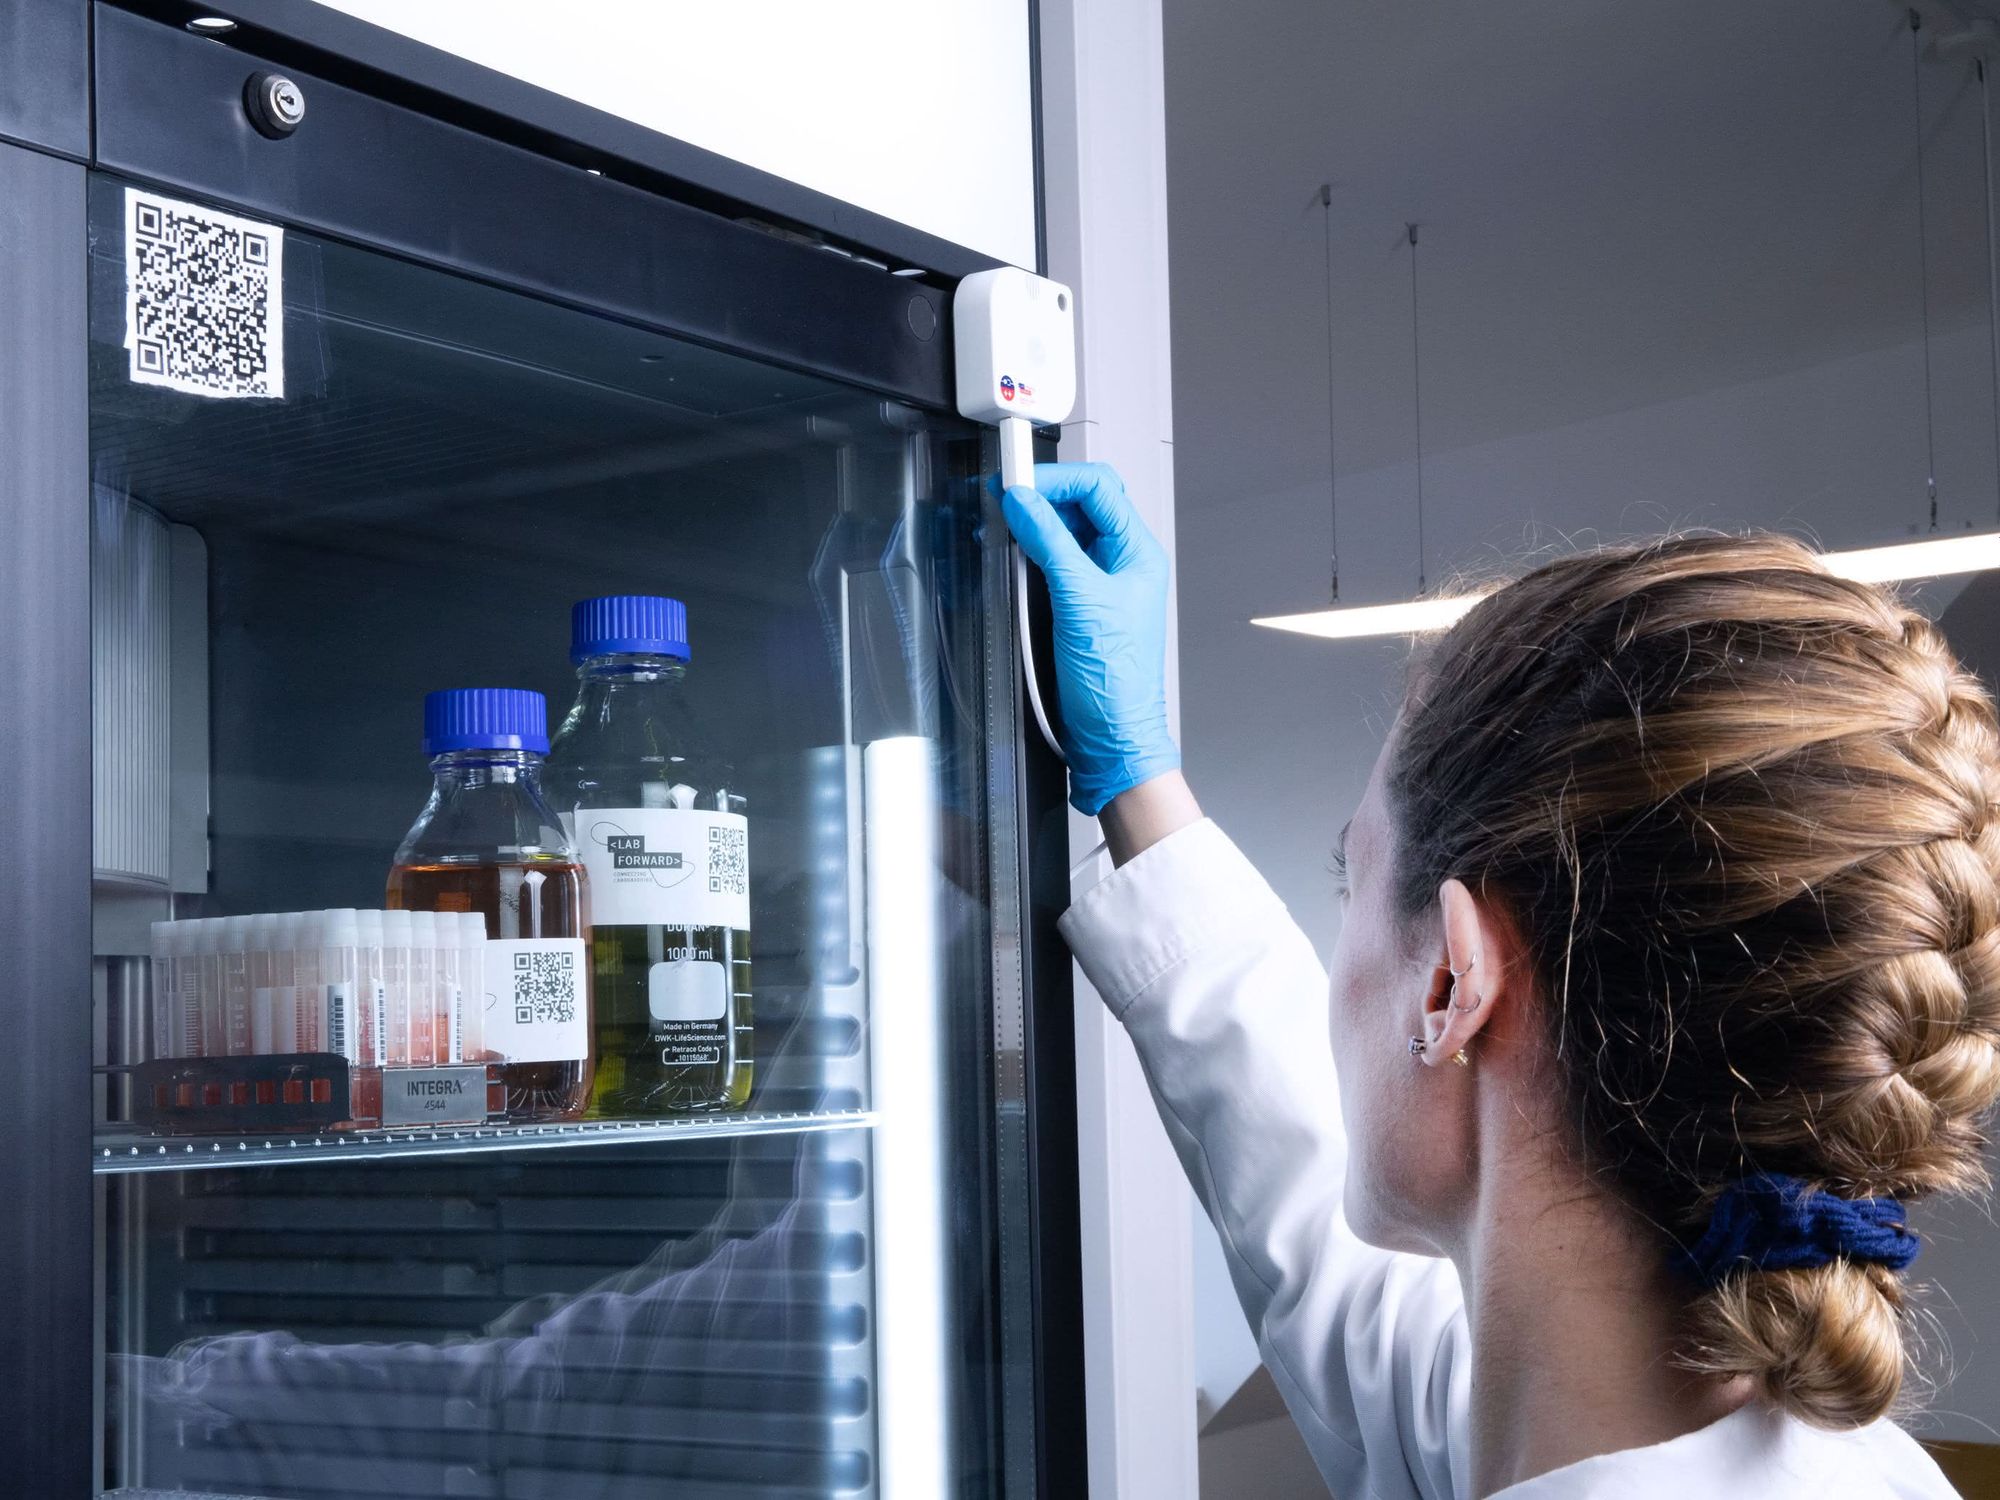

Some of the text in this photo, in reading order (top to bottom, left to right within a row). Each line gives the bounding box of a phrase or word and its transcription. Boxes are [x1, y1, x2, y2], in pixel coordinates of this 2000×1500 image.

[667, 947, 713, 960] 1000 ml
[691, 1022, 719, 1031] Germany
[655, 1033, 727, 1042] DWK-LifeSciences.com
[407, 1080, 462, 1096] INTEGRA
[424, 1100, 446, 1111] 4544
